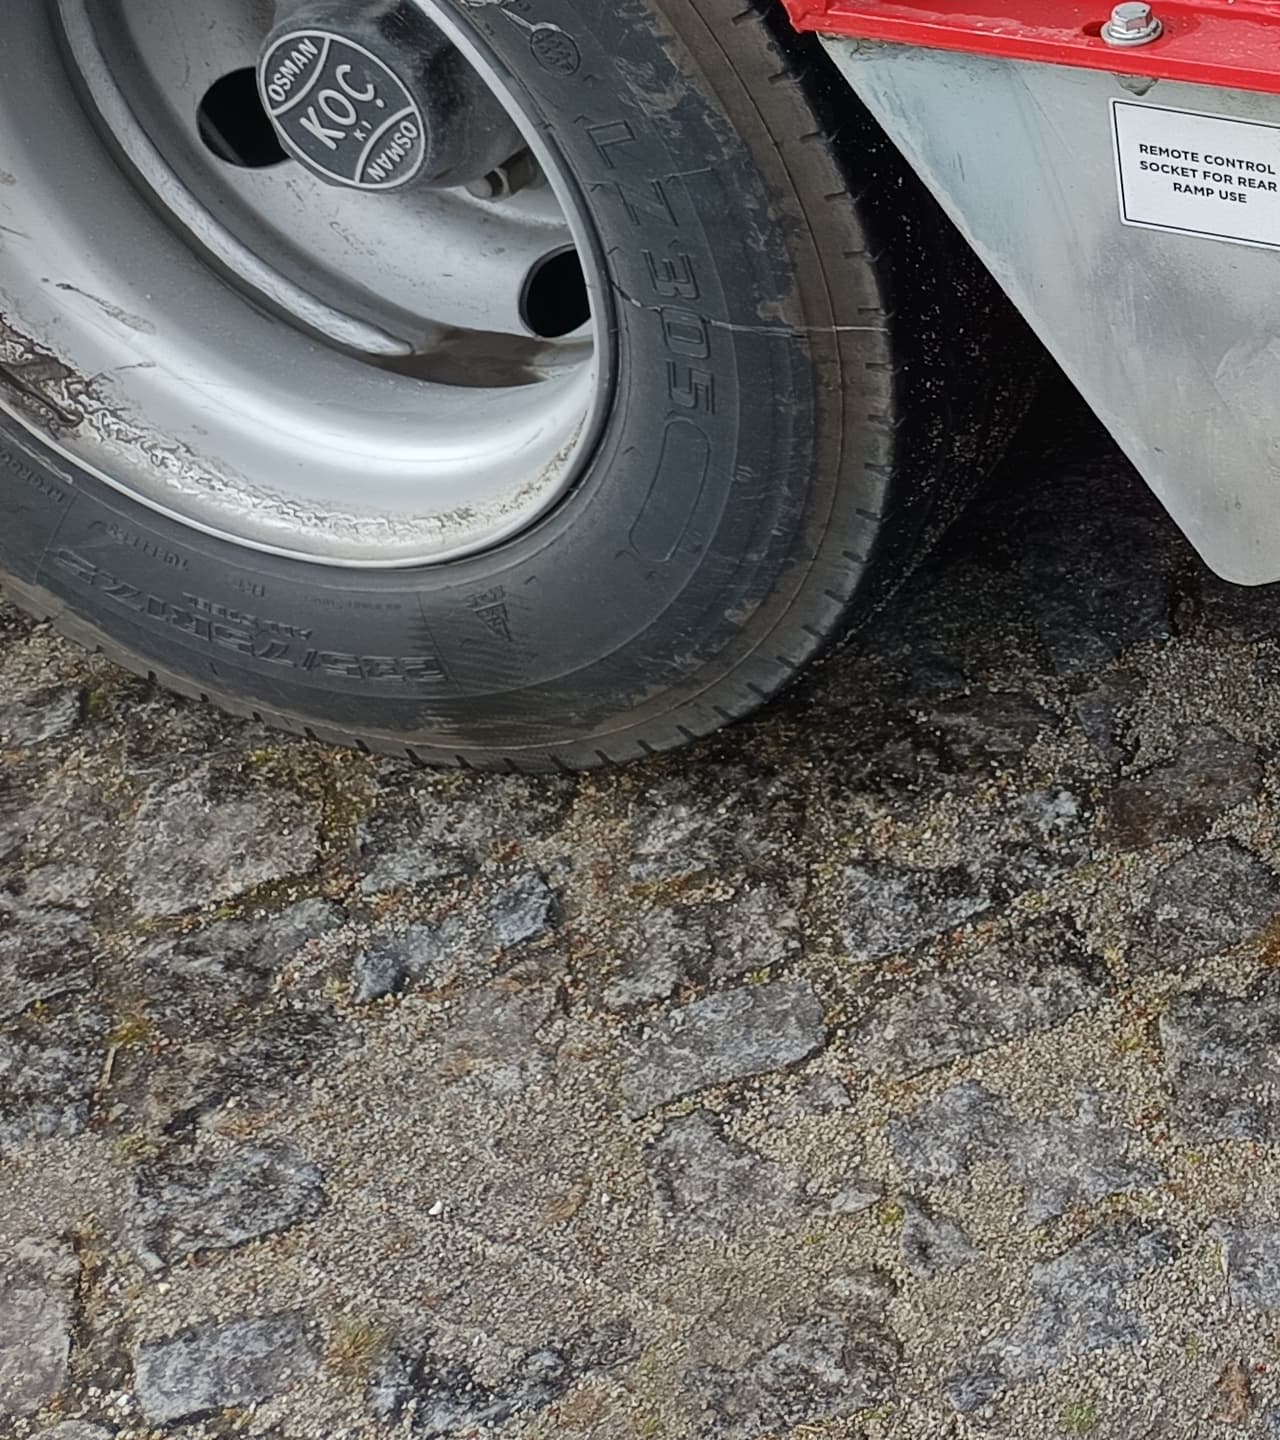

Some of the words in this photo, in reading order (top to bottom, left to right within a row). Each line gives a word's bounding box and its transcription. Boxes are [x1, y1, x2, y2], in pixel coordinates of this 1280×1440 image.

[267, 38, 319, 102] OSMAN
[367, 120, 419, 182] OSMAN
[1139, 143, 1200, 163] REMOTE
[1204, 154, 1276, 175] CONTROL
[1139, 160, 1199, 179] SOCKET
[1203, 170, 1233, 185] FOR
[1237, 176, 1278, 192] REAR
[1173, 182, 1215, 198] RAMP
[1219, 190, 1248, 203] USE
